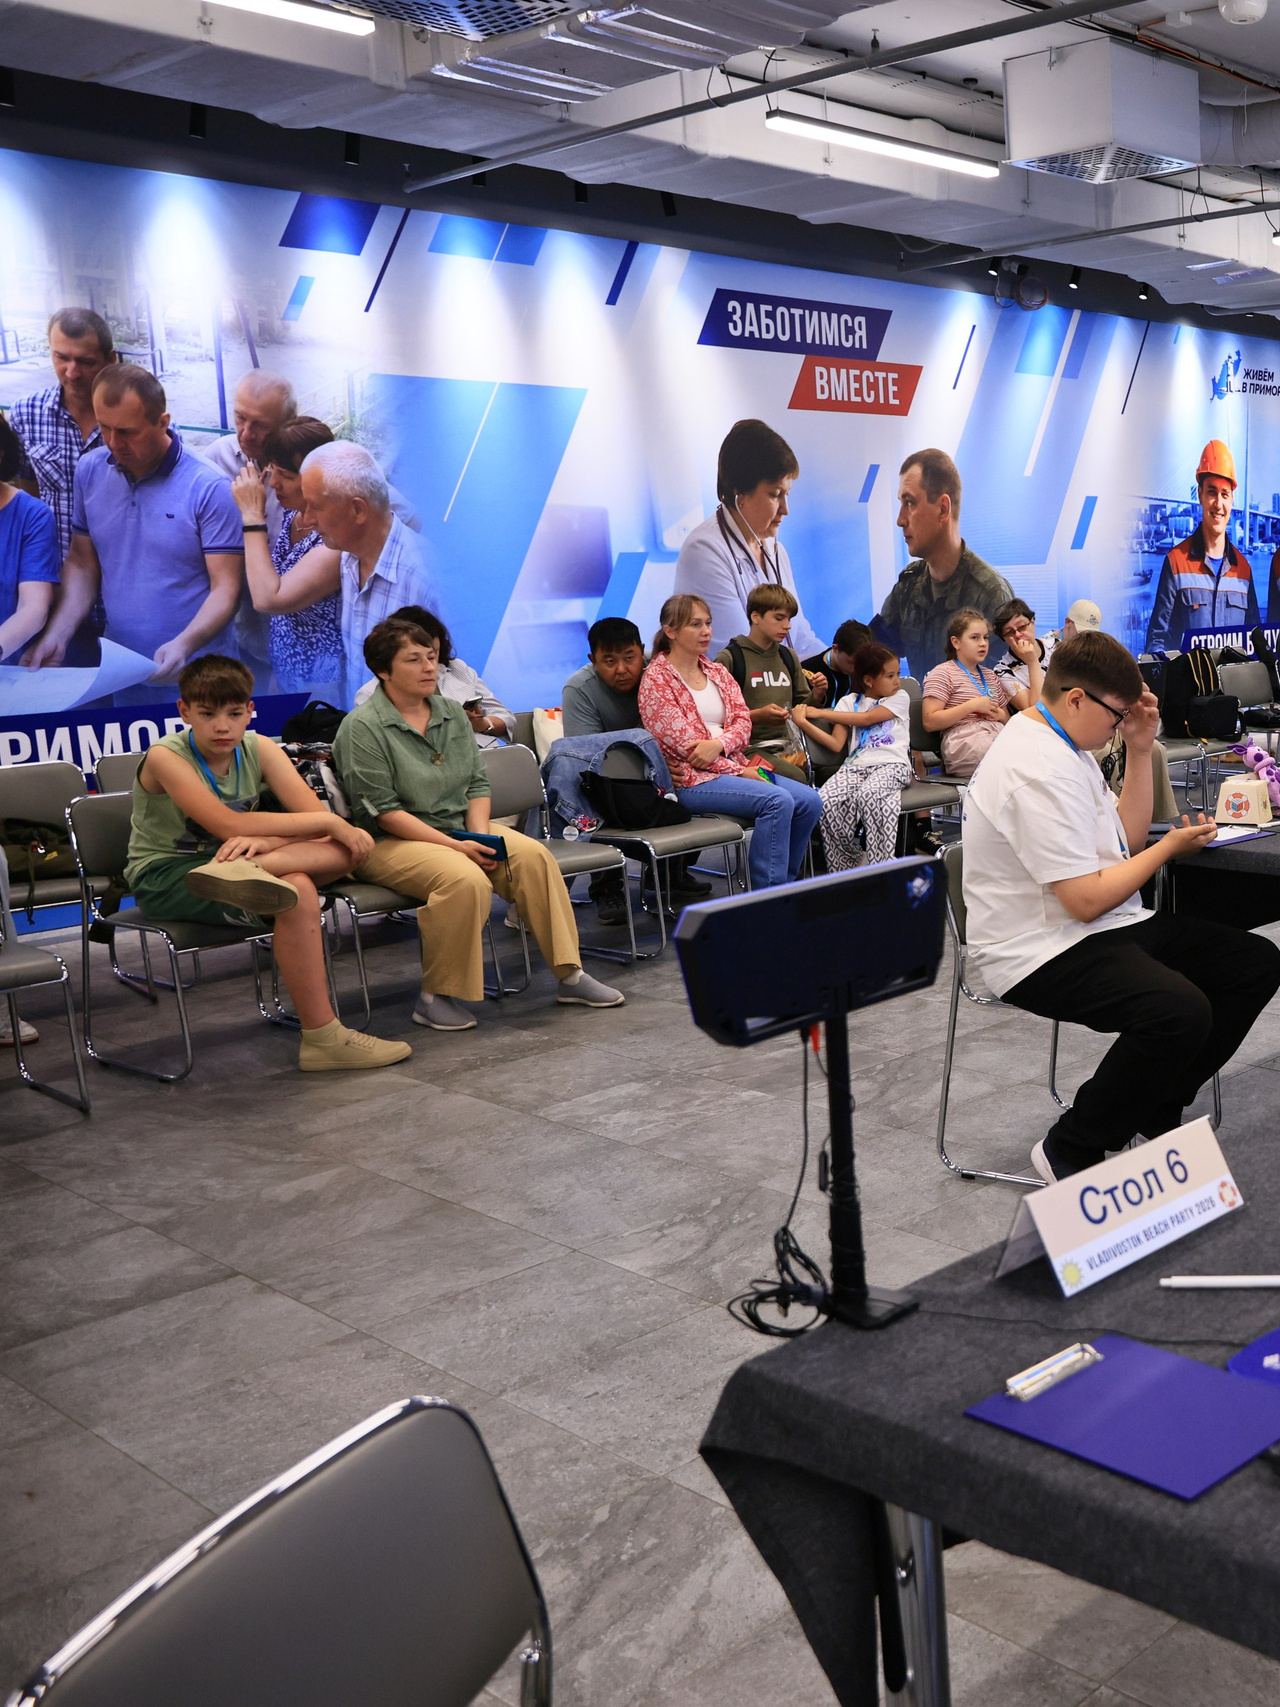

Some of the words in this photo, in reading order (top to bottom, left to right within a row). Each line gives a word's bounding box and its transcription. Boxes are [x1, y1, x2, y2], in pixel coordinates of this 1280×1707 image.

[727, 300, 868, 350] ЗАБОТИМСЯ
[814, 366, 900, 405] ВМЕСТЕ
[1241, 382, 1249, 393] В
[1242, 367, 1275, 383] ЖИВЁМ
[750, 671, 791, 688] FILA
[1079, 1168, 1165, 1225] Стол
[1165, 1149, 1189, 1184] 6
[1086, 1233, 1143, 1270] VLADIVOSTOK
[1143, 1220, 1170, 1242] BEACH
[1170, 1206, 1197, 1228] PARTY
